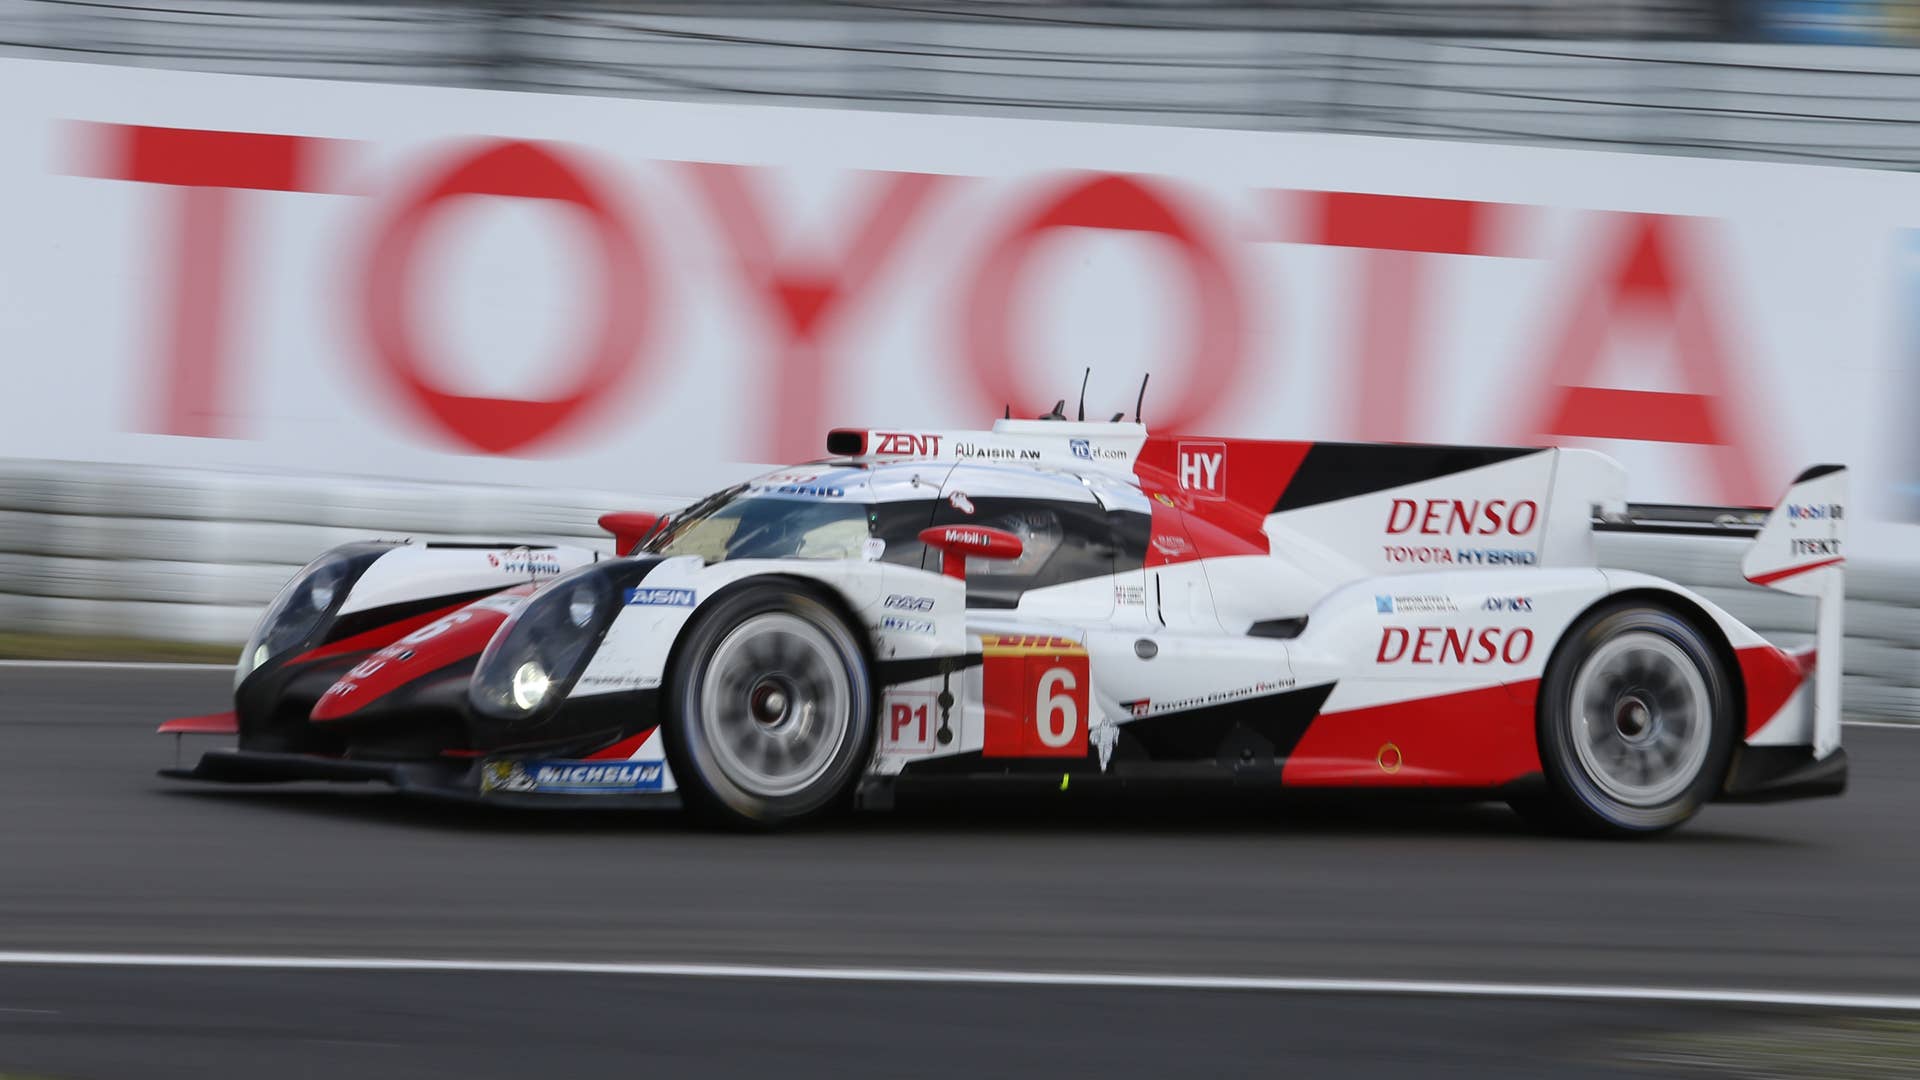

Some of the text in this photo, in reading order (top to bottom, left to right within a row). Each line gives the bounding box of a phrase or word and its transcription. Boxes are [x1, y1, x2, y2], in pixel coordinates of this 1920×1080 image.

[62, 118, 1785, 508] TOYOTA
[875, 432, 943, 456] ZENT
[977, 446, 1015, 458] AISIN
[1020, 449, 1040, 459] AW
[1180, 453, 1221, 490] HY
[1385, 499, 1538, 536] DENSO
[1787, 504, 1825, 519] Mobil
[945, 530, 979, 543] Mobil
[1791, 539, 1841, 555] JTEKT
[1383, 546, 1537, 567] TOYOTA HYBRID
[505, 562, 560, 575] HYBRID
[630, 589, 692, 606] AISIN
[401, 612, 472, 645] 6
[998, 635, 1073, 648] DHL
[1376, 627, 1535, 664] DENSO
[1036, 667, 1078, 748] 6
[890, 704, 928, 742] P1
[536, 765, 662, 783] MICHELIN
